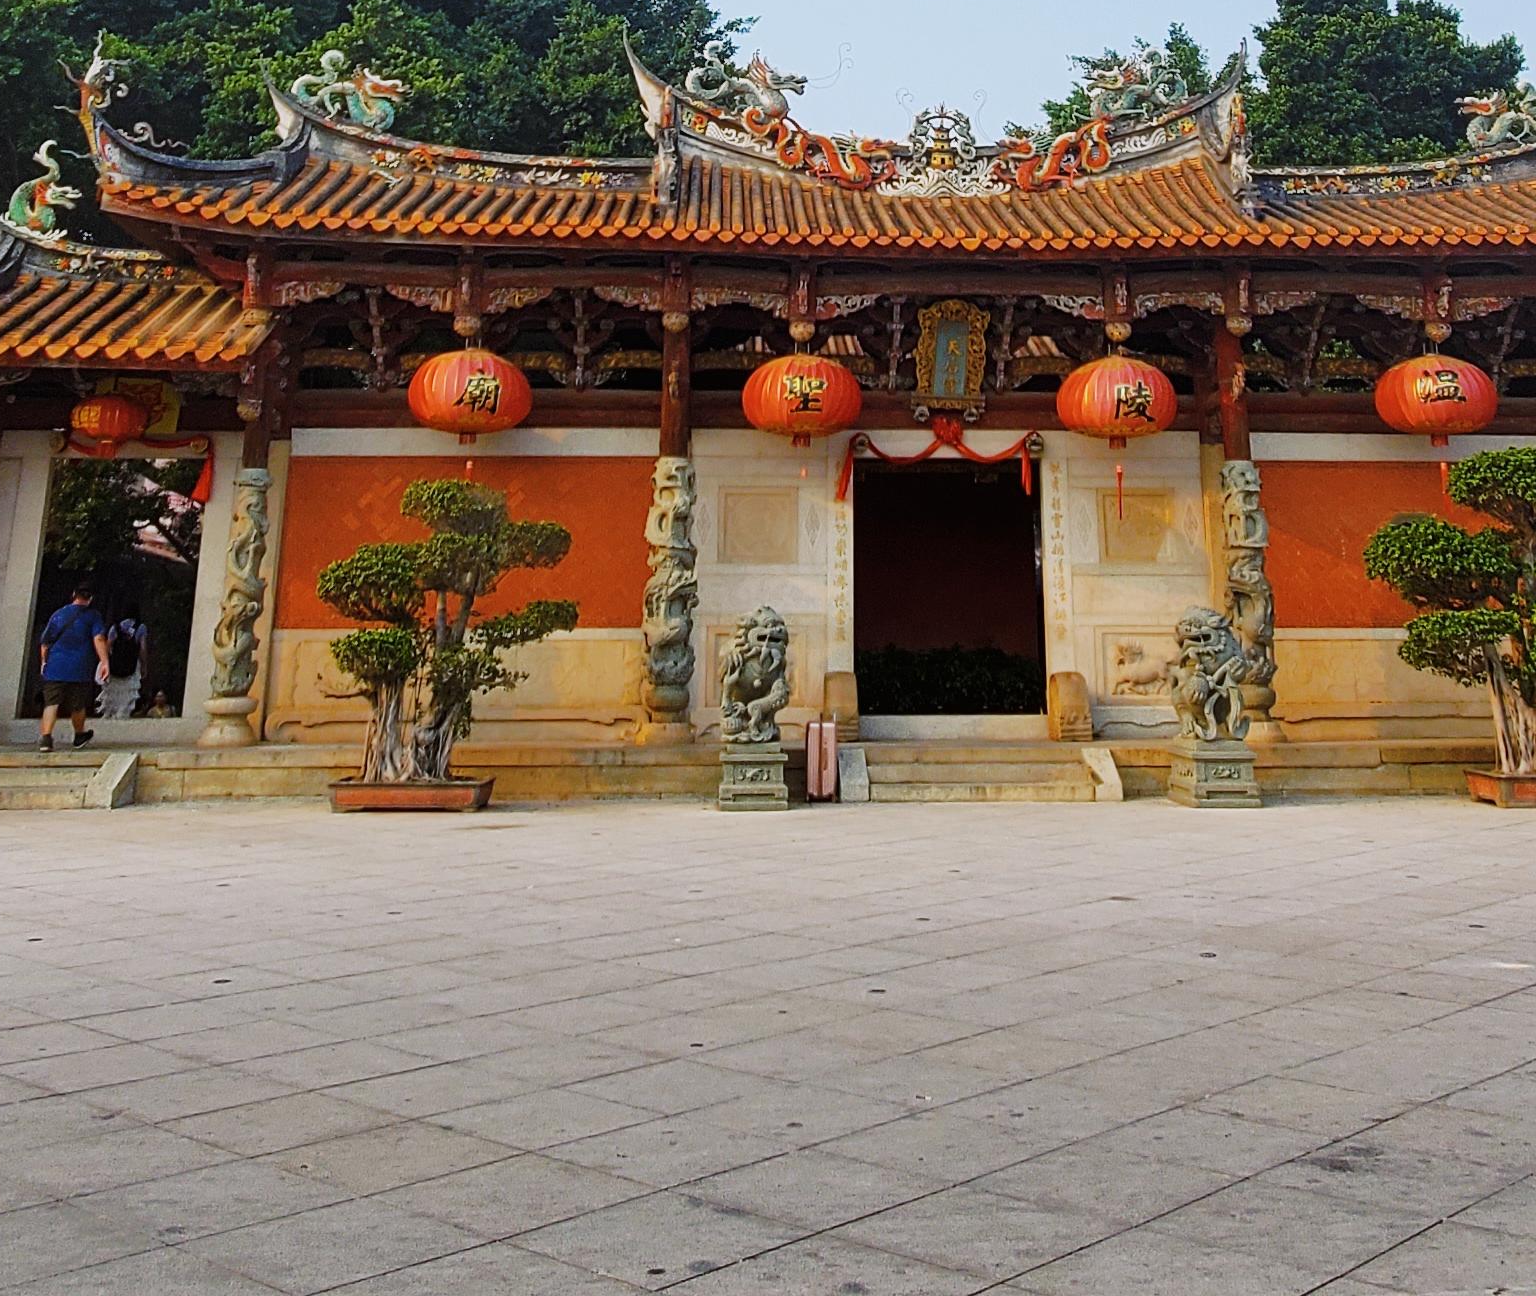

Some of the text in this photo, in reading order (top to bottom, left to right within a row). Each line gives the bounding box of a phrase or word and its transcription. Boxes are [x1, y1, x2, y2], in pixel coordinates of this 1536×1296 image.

[452, 369, 500, 415] 廟
[784, 374, 827, 413] 聖
[1115, 381, 1155, 421] 陵
